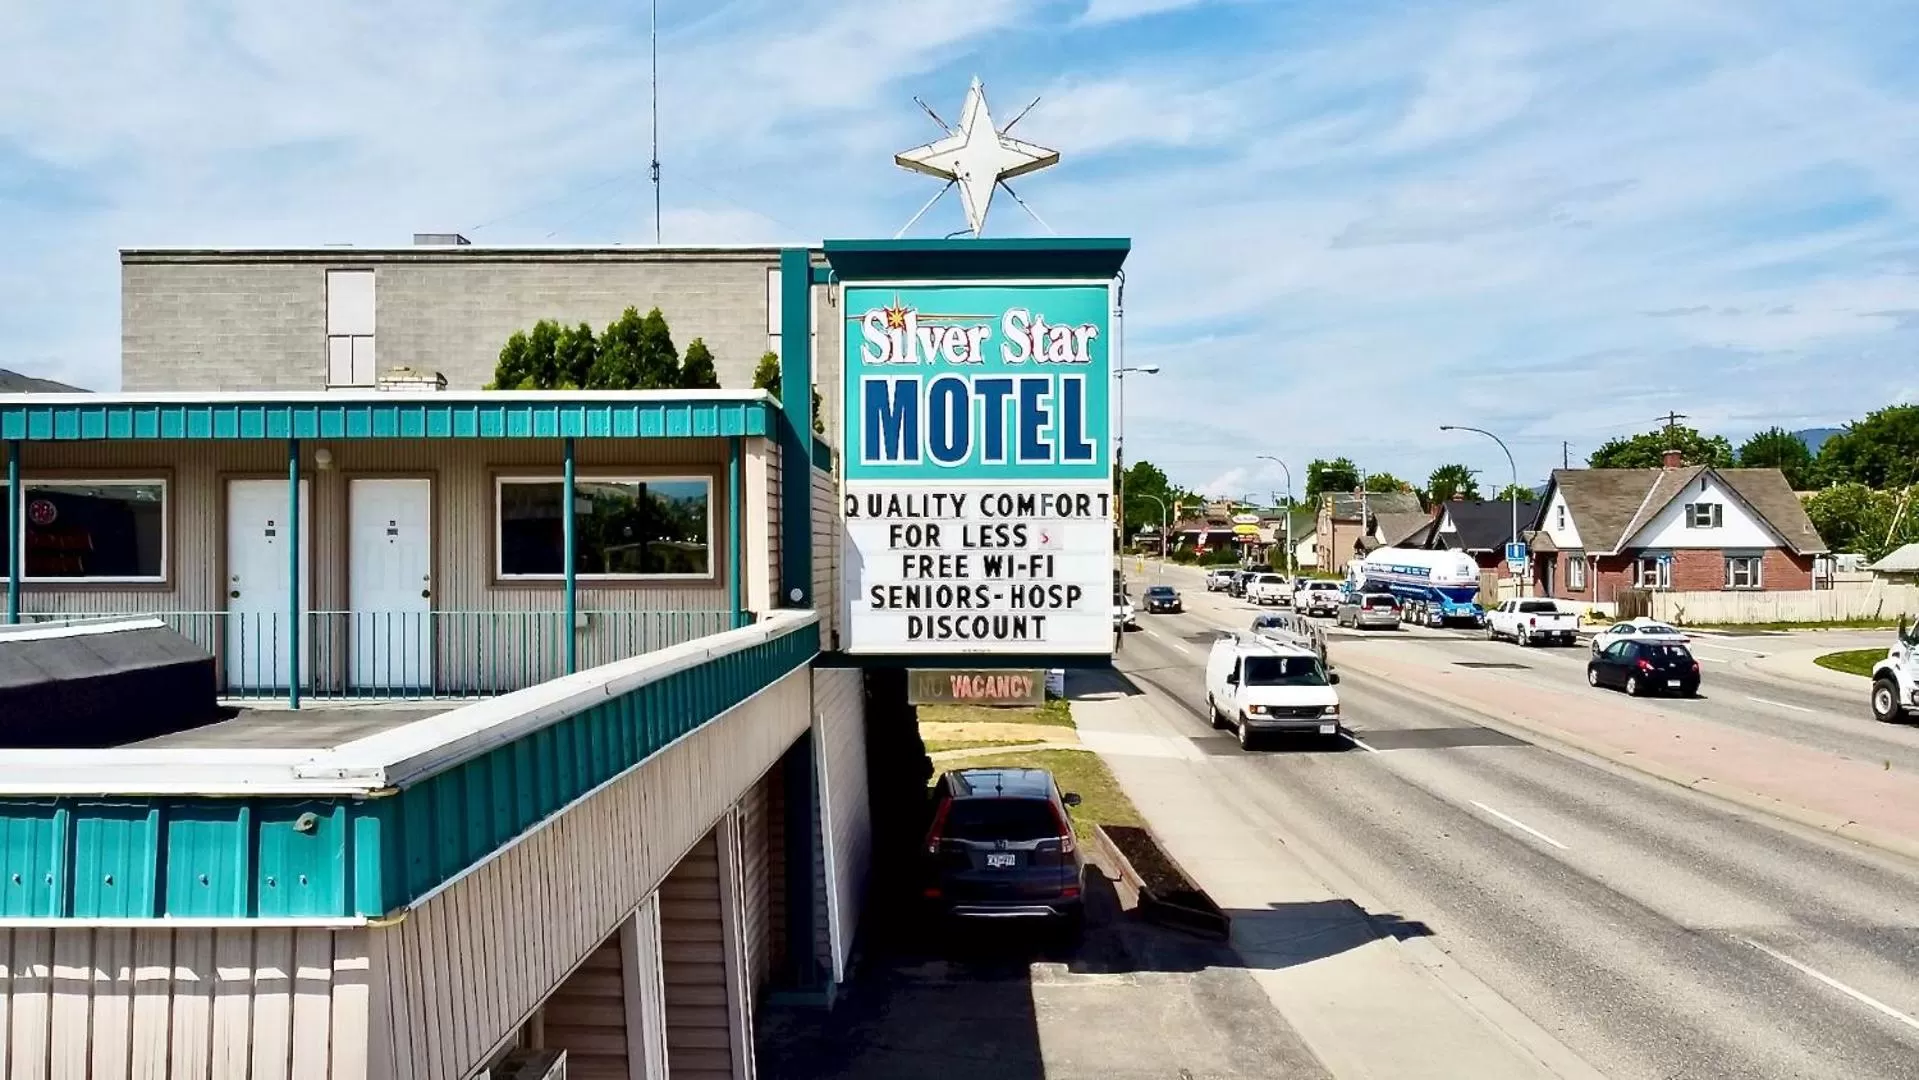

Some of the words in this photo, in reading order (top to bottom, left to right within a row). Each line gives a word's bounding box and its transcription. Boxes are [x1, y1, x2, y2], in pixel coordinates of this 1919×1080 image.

[860, 306, 992, 366] Silver
[1001, 308, 1099, 366] Star
[860, 373, 1097, 467] MOTEL
[845, 493, 967, 518] QUALITY
[979, 493, 1109, 518] COMFORT
[889, 524, 941, 549] FOR
[963, 524, 1028, 548] LESS
[903, 555, 969, 579] FREE
[983, 555, 1055, 579] WI-FI
[908, 615, 1046, 640] DISCOUNT
[919, 676, 943, 697] NO
[951, 674, 1034, 698] VACANCY
